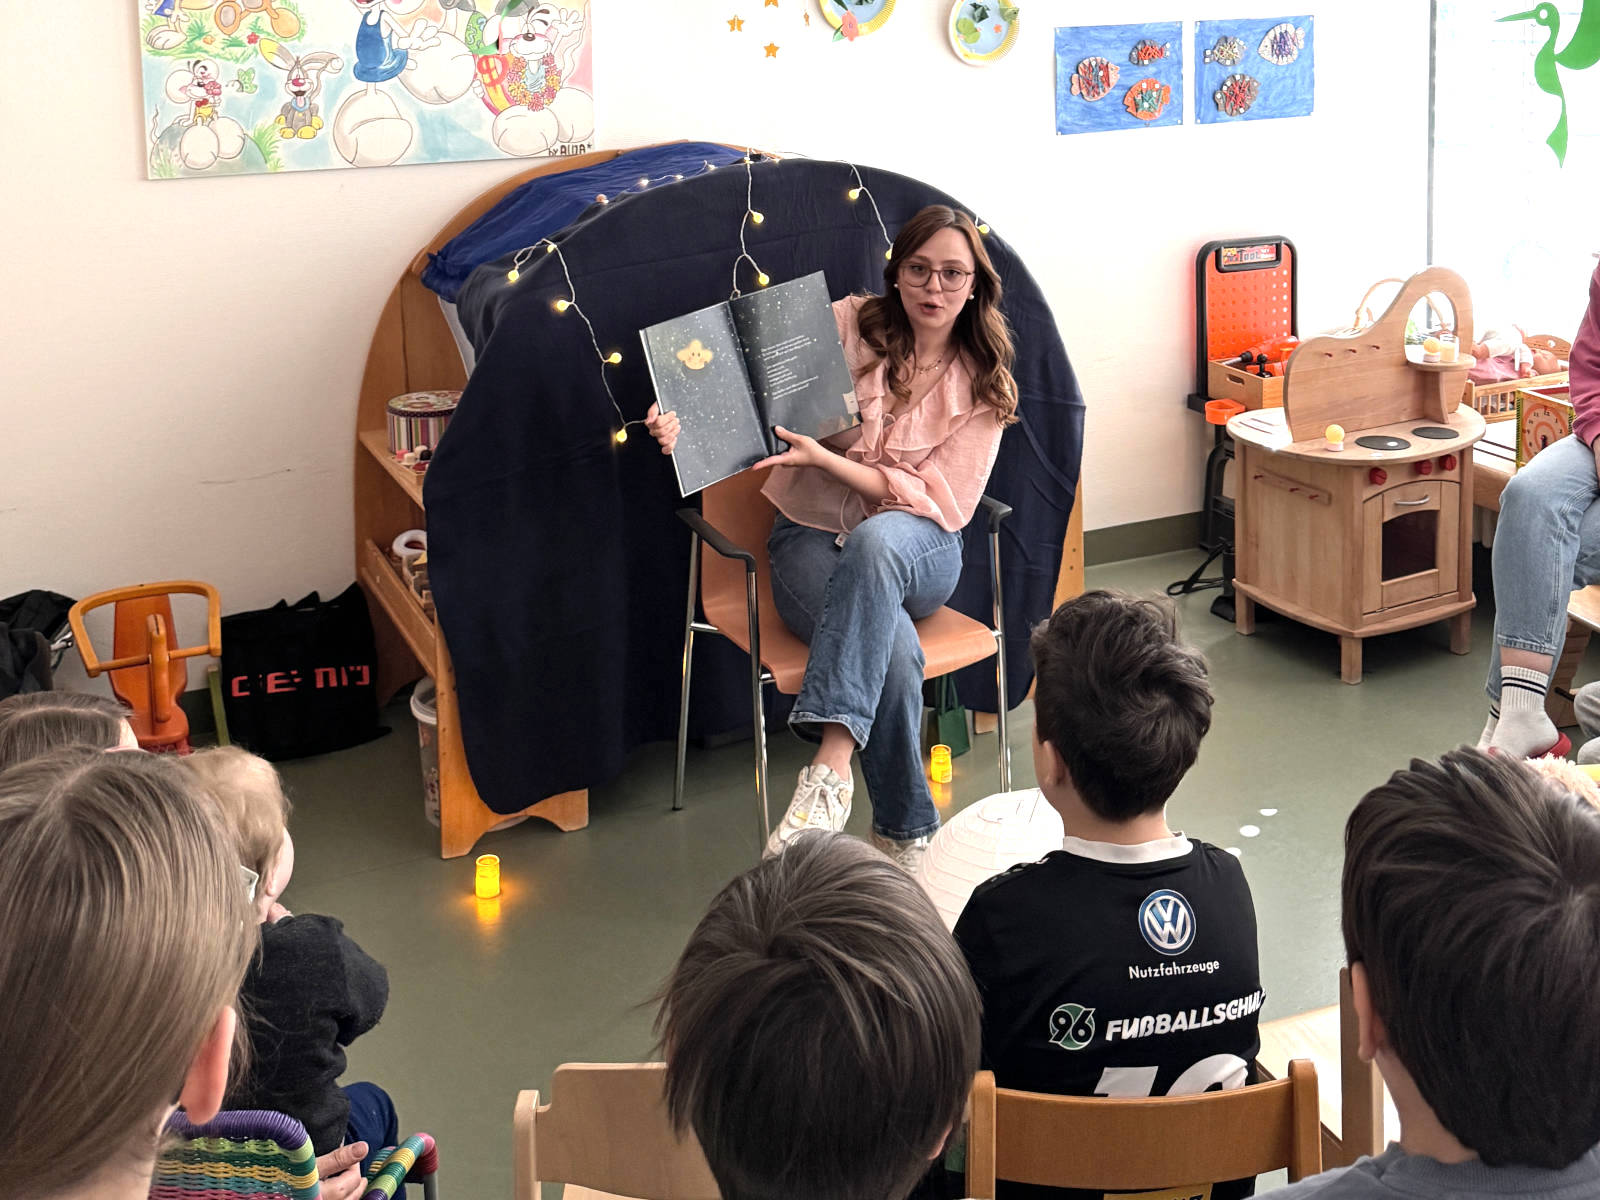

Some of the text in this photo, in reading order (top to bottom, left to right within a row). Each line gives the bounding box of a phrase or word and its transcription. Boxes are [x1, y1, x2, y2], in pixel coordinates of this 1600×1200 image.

[1142, 894, 1194, 951] VW
[1128, 960, 1220, 980] Nutzfahrzeuge
[1049, 1003, 1096, 1050] 96
